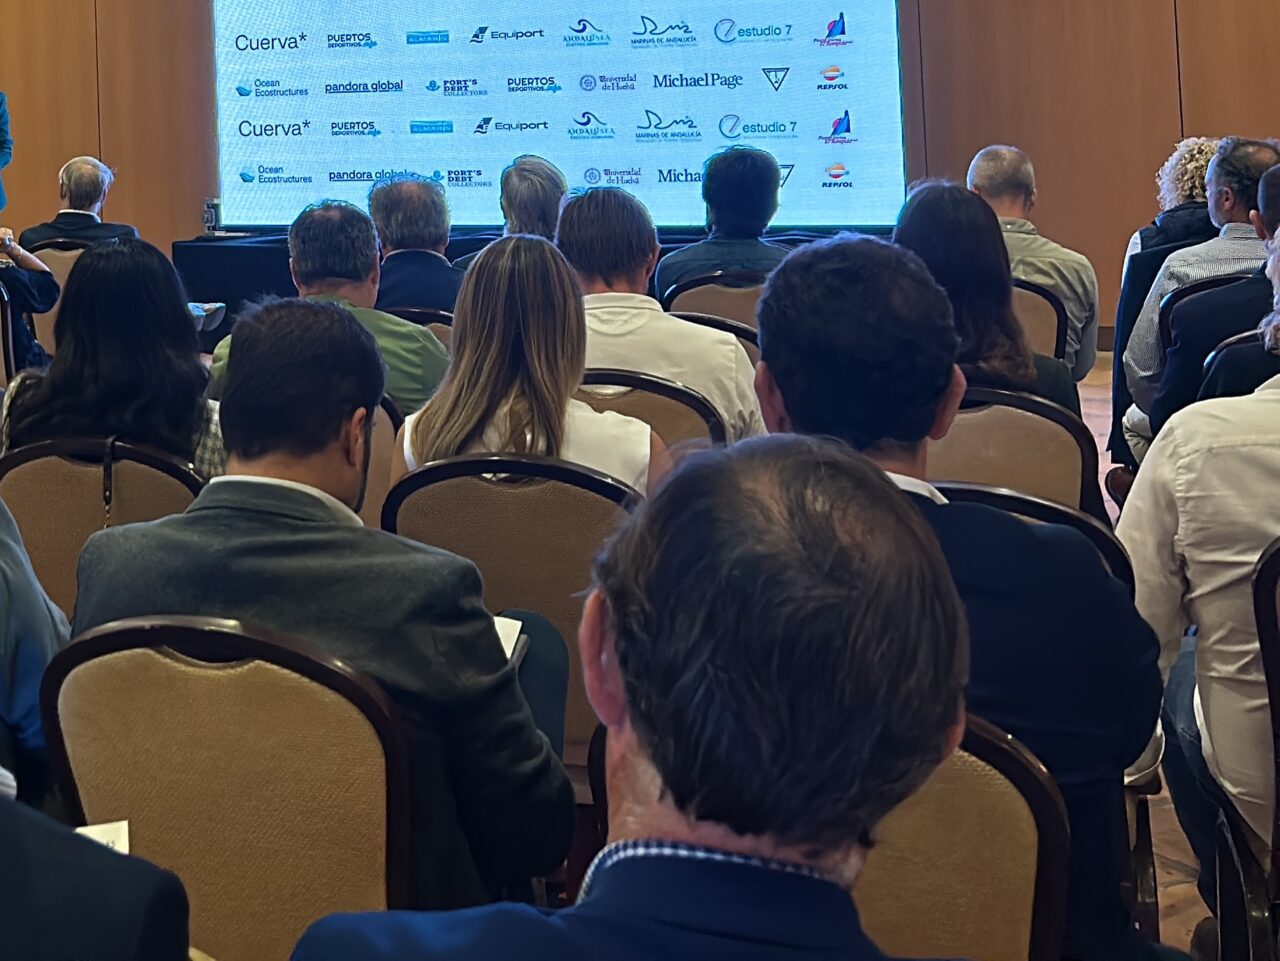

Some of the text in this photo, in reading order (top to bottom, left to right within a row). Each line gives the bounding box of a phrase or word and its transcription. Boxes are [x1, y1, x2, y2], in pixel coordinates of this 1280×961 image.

[491, 29, 544, 40] Equiport
[737, 25, 792, 37] estudio 7
[327, 33, 371, 42] PUERTOS
[254, 79, 280, 87] Ocean
[325, 80, 403, 93] pandora global
[507, 77, 555, 86] PUERTOS
[653, 73, 743, 89] Michael Page
[255, 87, 309, 97] Ecostructures
[331, 121, 375, 130] PUERTOS
[495, 121, 548, 132] Equiport
[742, 121, 797, 133] estudio 7
[258, 165, 284, 174] Ocean
[258, 174, 312, 183] Ecostructures
[329, 170, 373, 182] pandora
[658, 169, 702, 183] Micha
